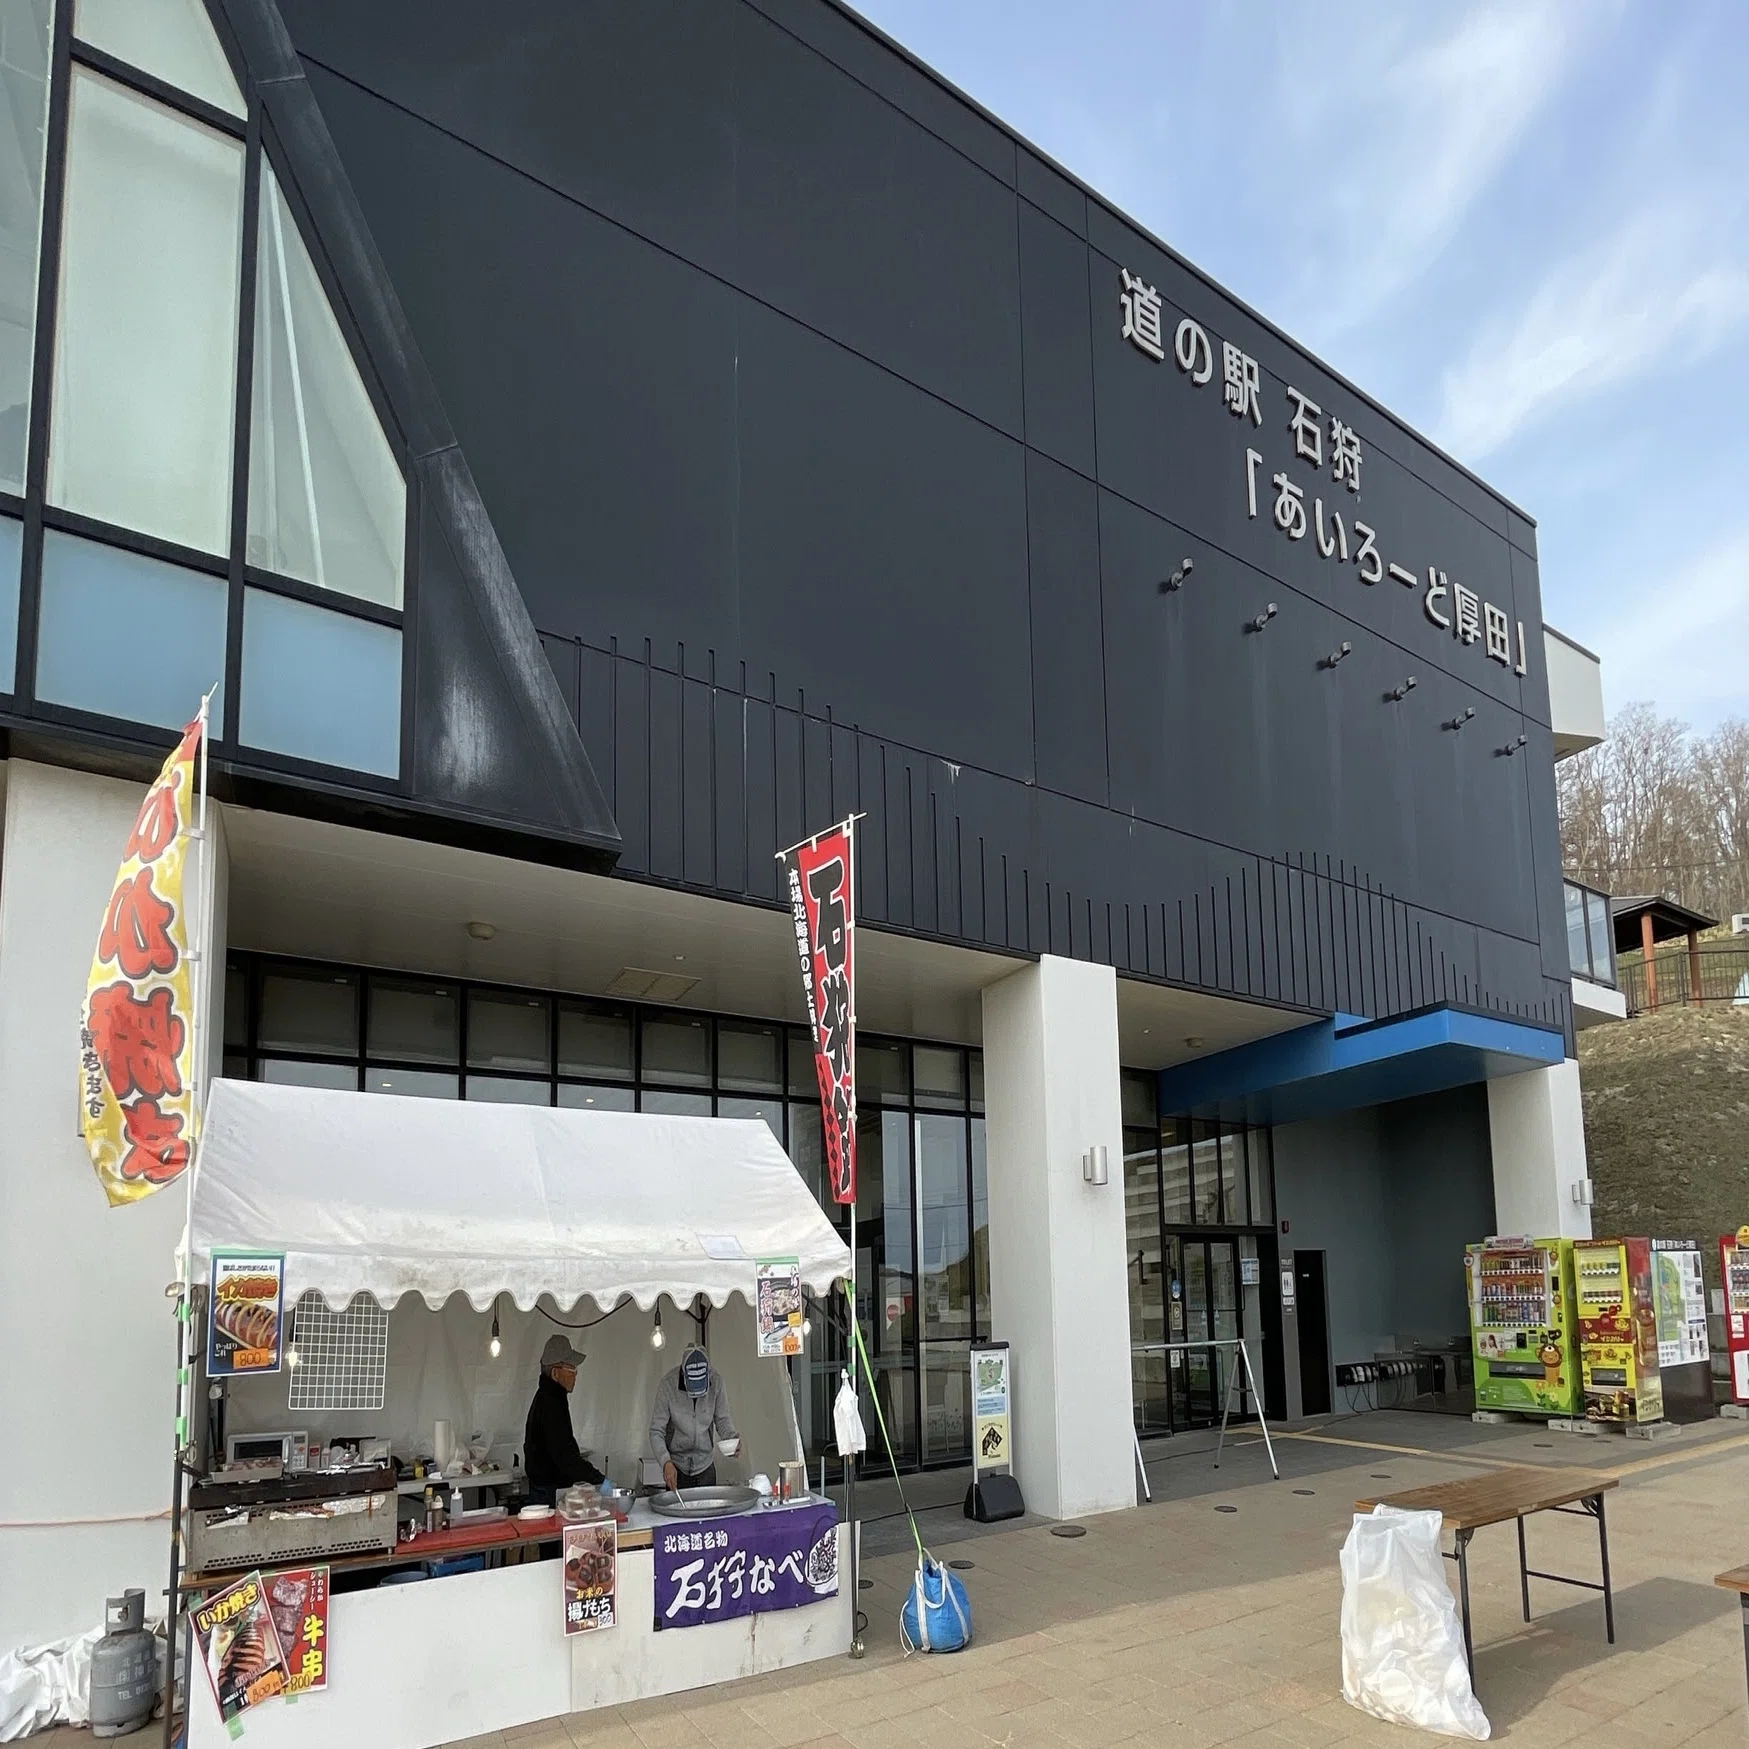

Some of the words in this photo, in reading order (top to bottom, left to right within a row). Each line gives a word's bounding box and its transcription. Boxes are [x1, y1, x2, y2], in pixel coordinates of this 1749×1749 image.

[1120, 268, 1263, 428] 道の駅
[1287, 385, 1363, 493] 石狩
[1246, 447, 1527, 677] 「あいろーど厚田」
[239, 1352, 261, 1366] 800
[664, 1530, 728, 1554] 北海道名物
[198, 1581, 261, 1632] いか焼き
[567, 1597, 611, 1623] 揚げもち
[665, 1549, 804, 1619] 石狩なべ
[302, 1614, 324, 1682] 牛串
